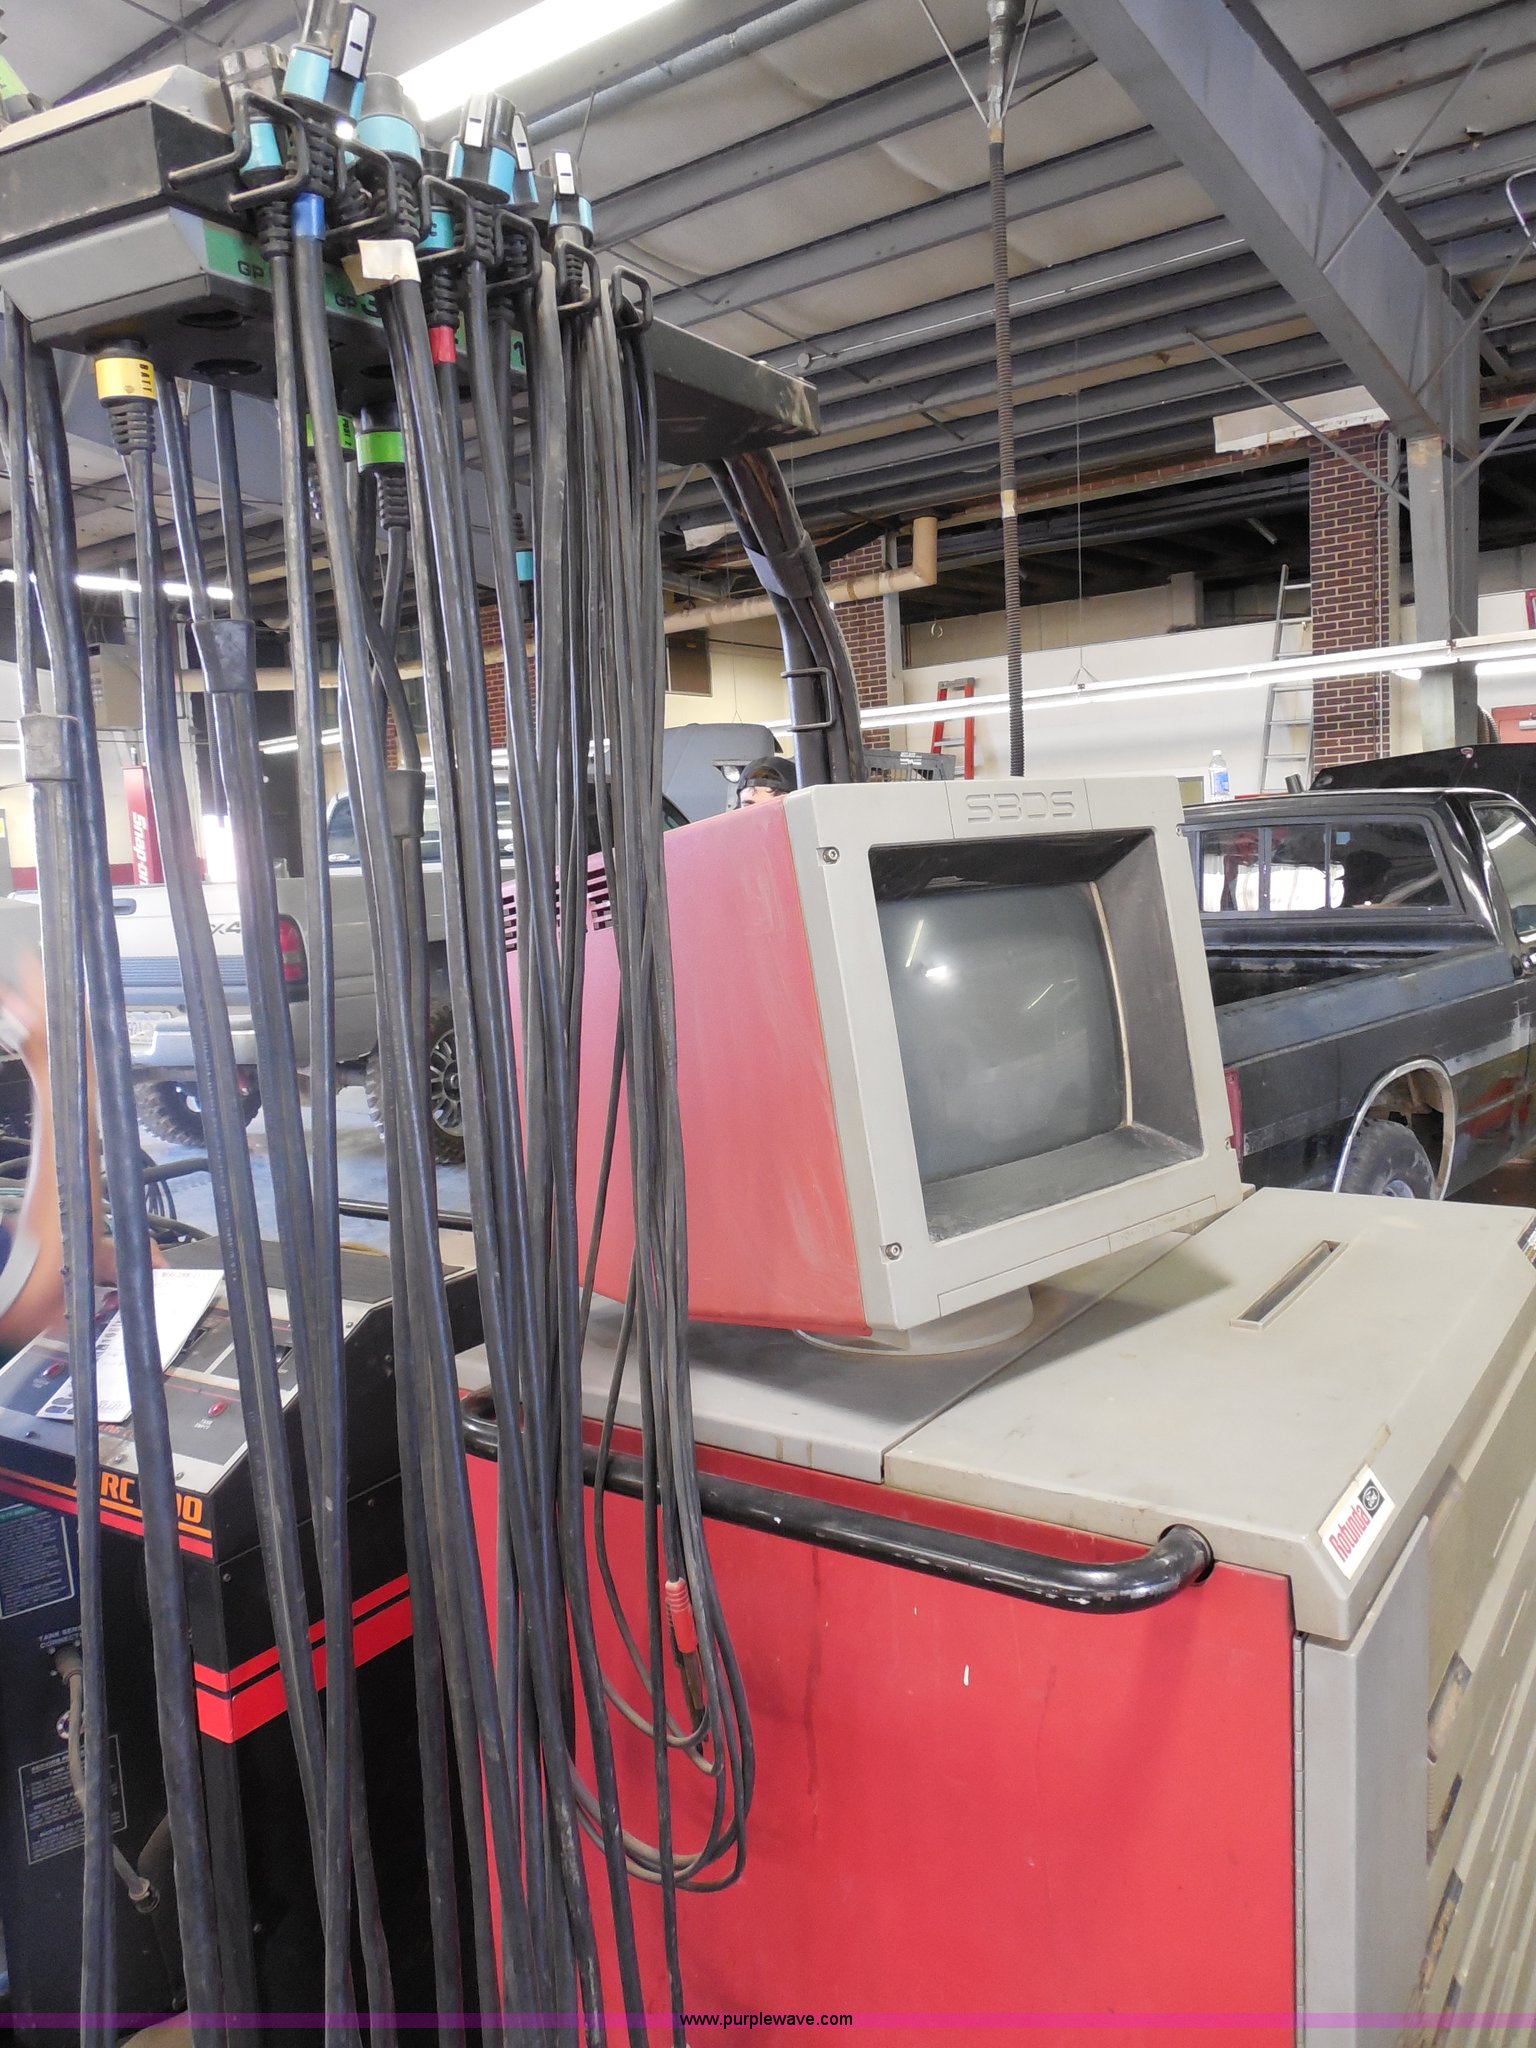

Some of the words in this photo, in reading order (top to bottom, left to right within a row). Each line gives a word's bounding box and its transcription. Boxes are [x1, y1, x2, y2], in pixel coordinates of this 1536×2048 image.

[237, 260, 264, 279] GP
[139, 363, 153, 393] BATT
[966, 790, 1075, 824] SBDS
[132, 811, 149, 886] Snap-on
[1328, 1504, 1371, 1563] Rotunda
